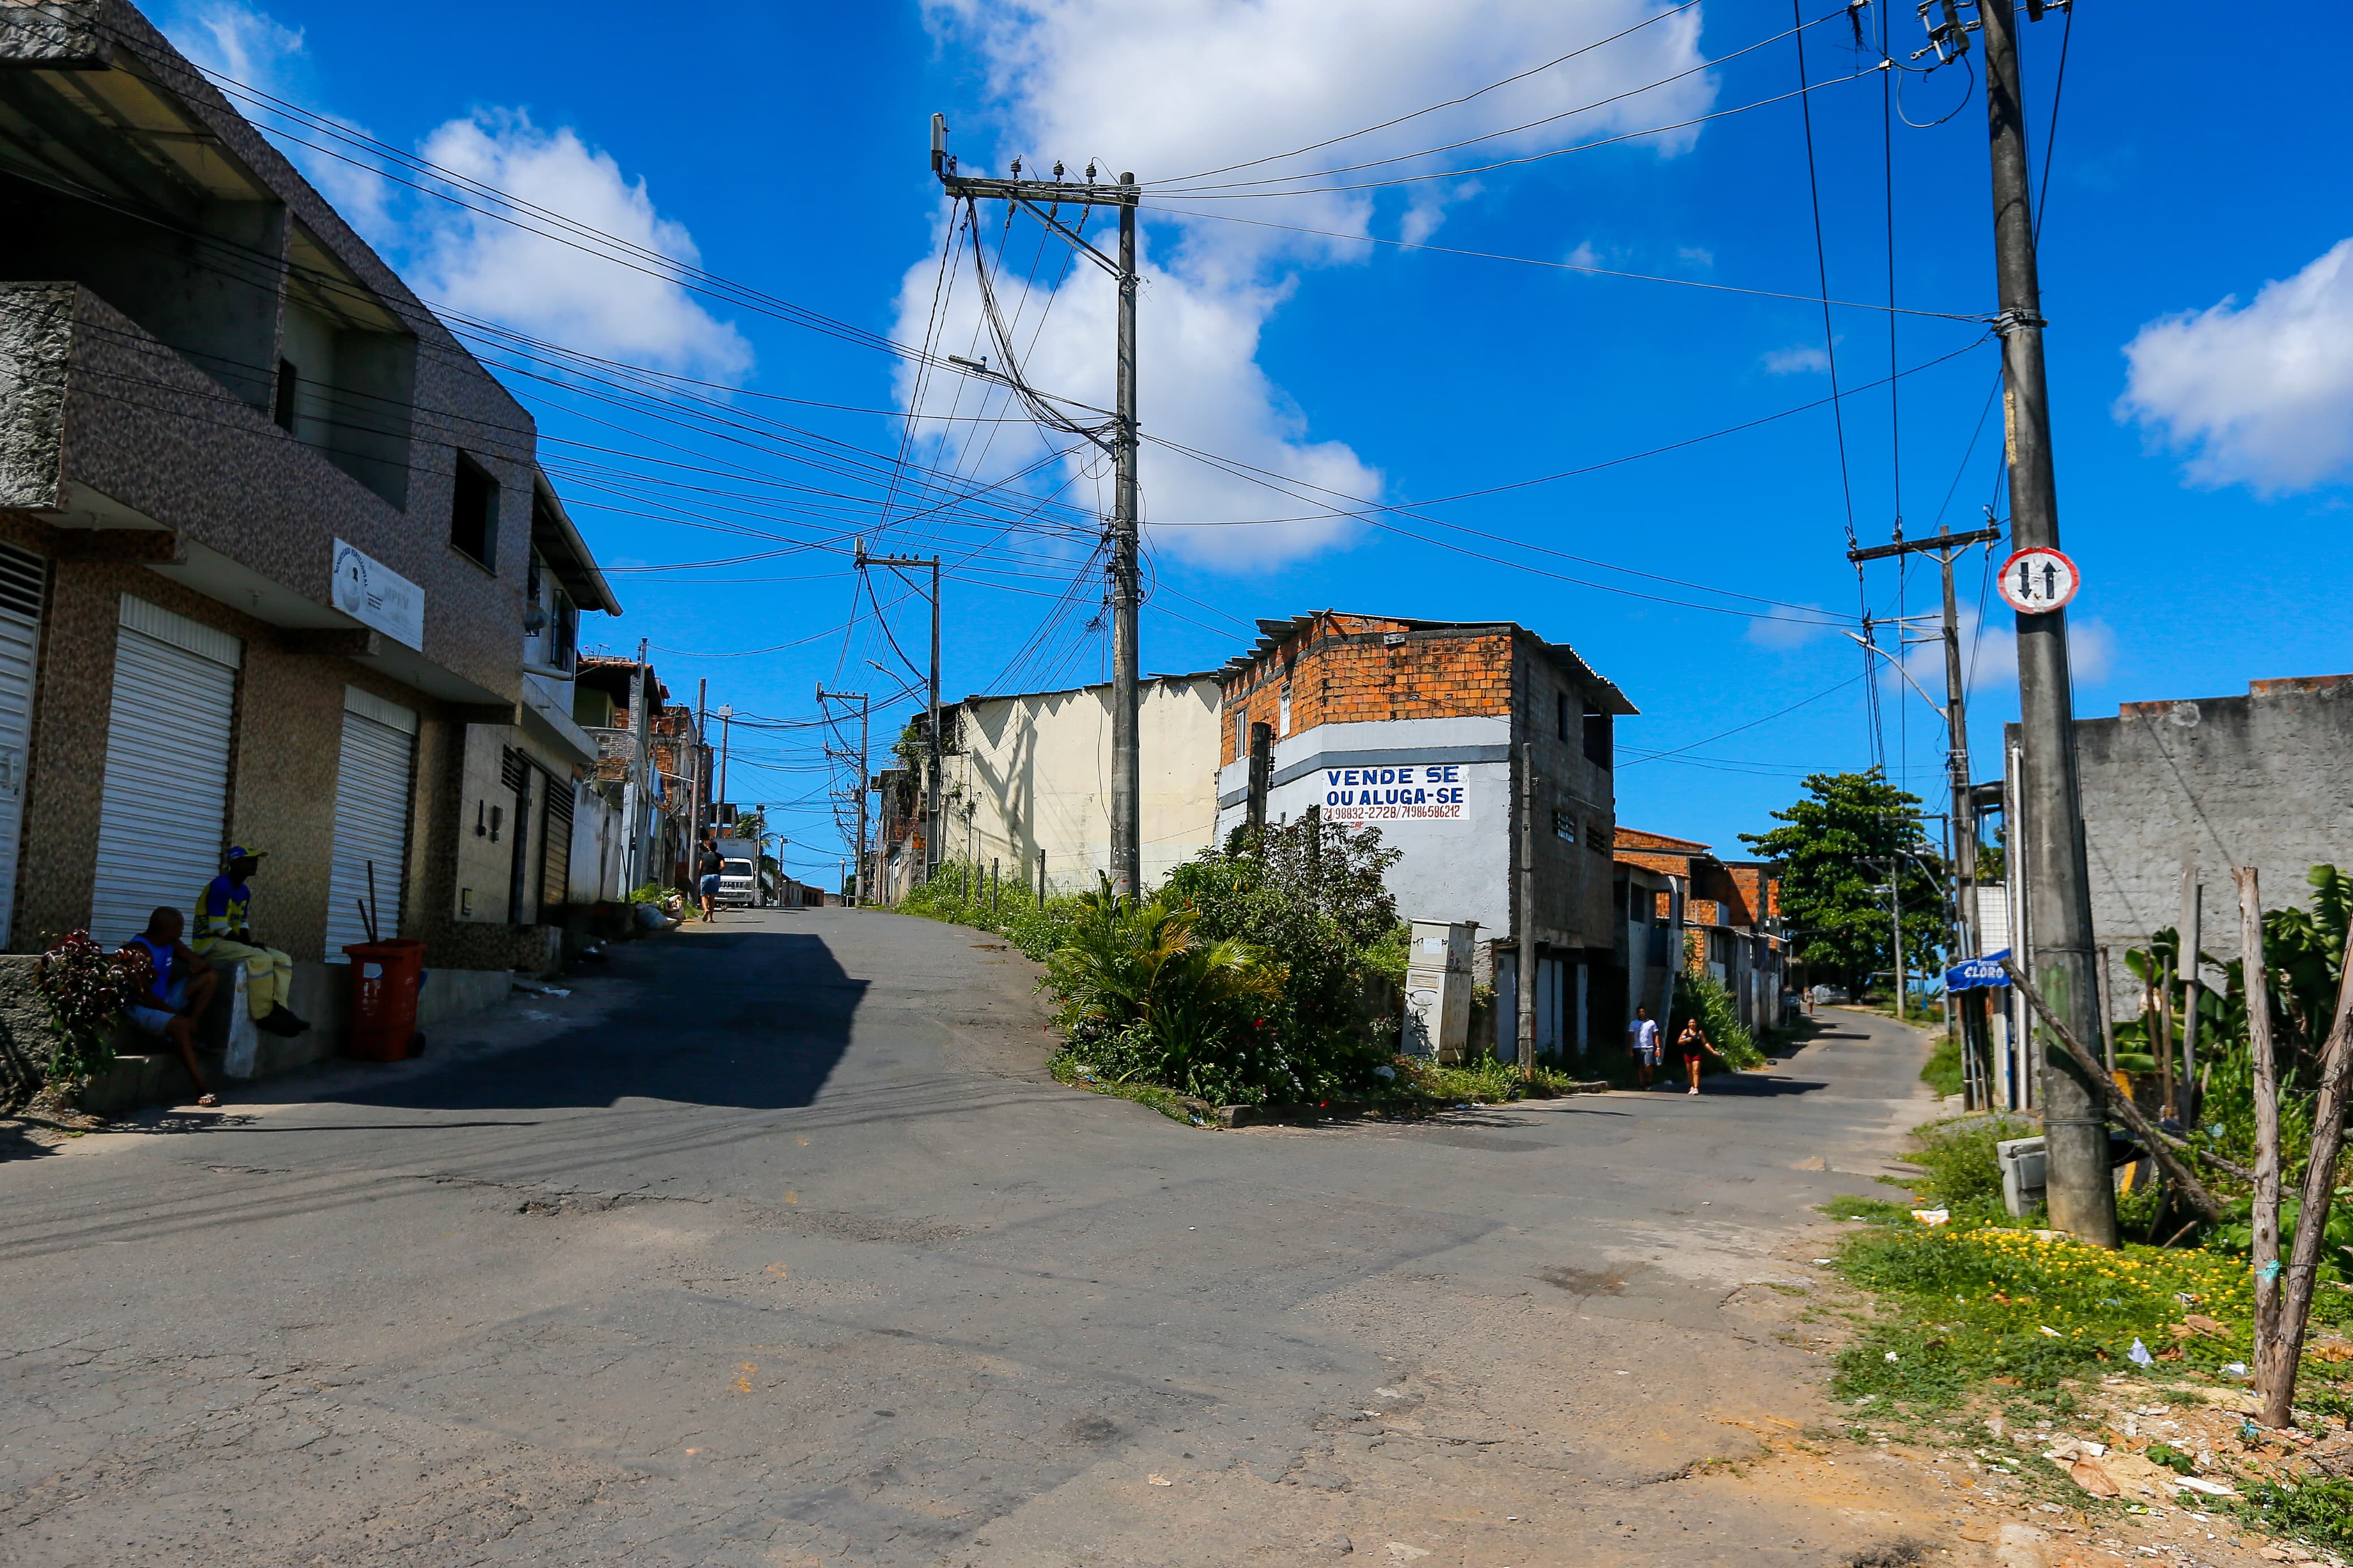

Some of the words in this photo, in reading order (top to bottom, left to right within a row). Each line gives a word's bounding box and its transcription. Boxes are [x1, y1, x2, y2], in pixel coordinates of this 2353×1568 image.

[1327, 768, 1413, 785] VENDE
[1426, 766, 1459, 783] SE
[1327, 791, 1353, 806] OU
[1359, 788, 1464, 805] ALUGA-SE
[1964, 966, 2005, 978] CLORO
